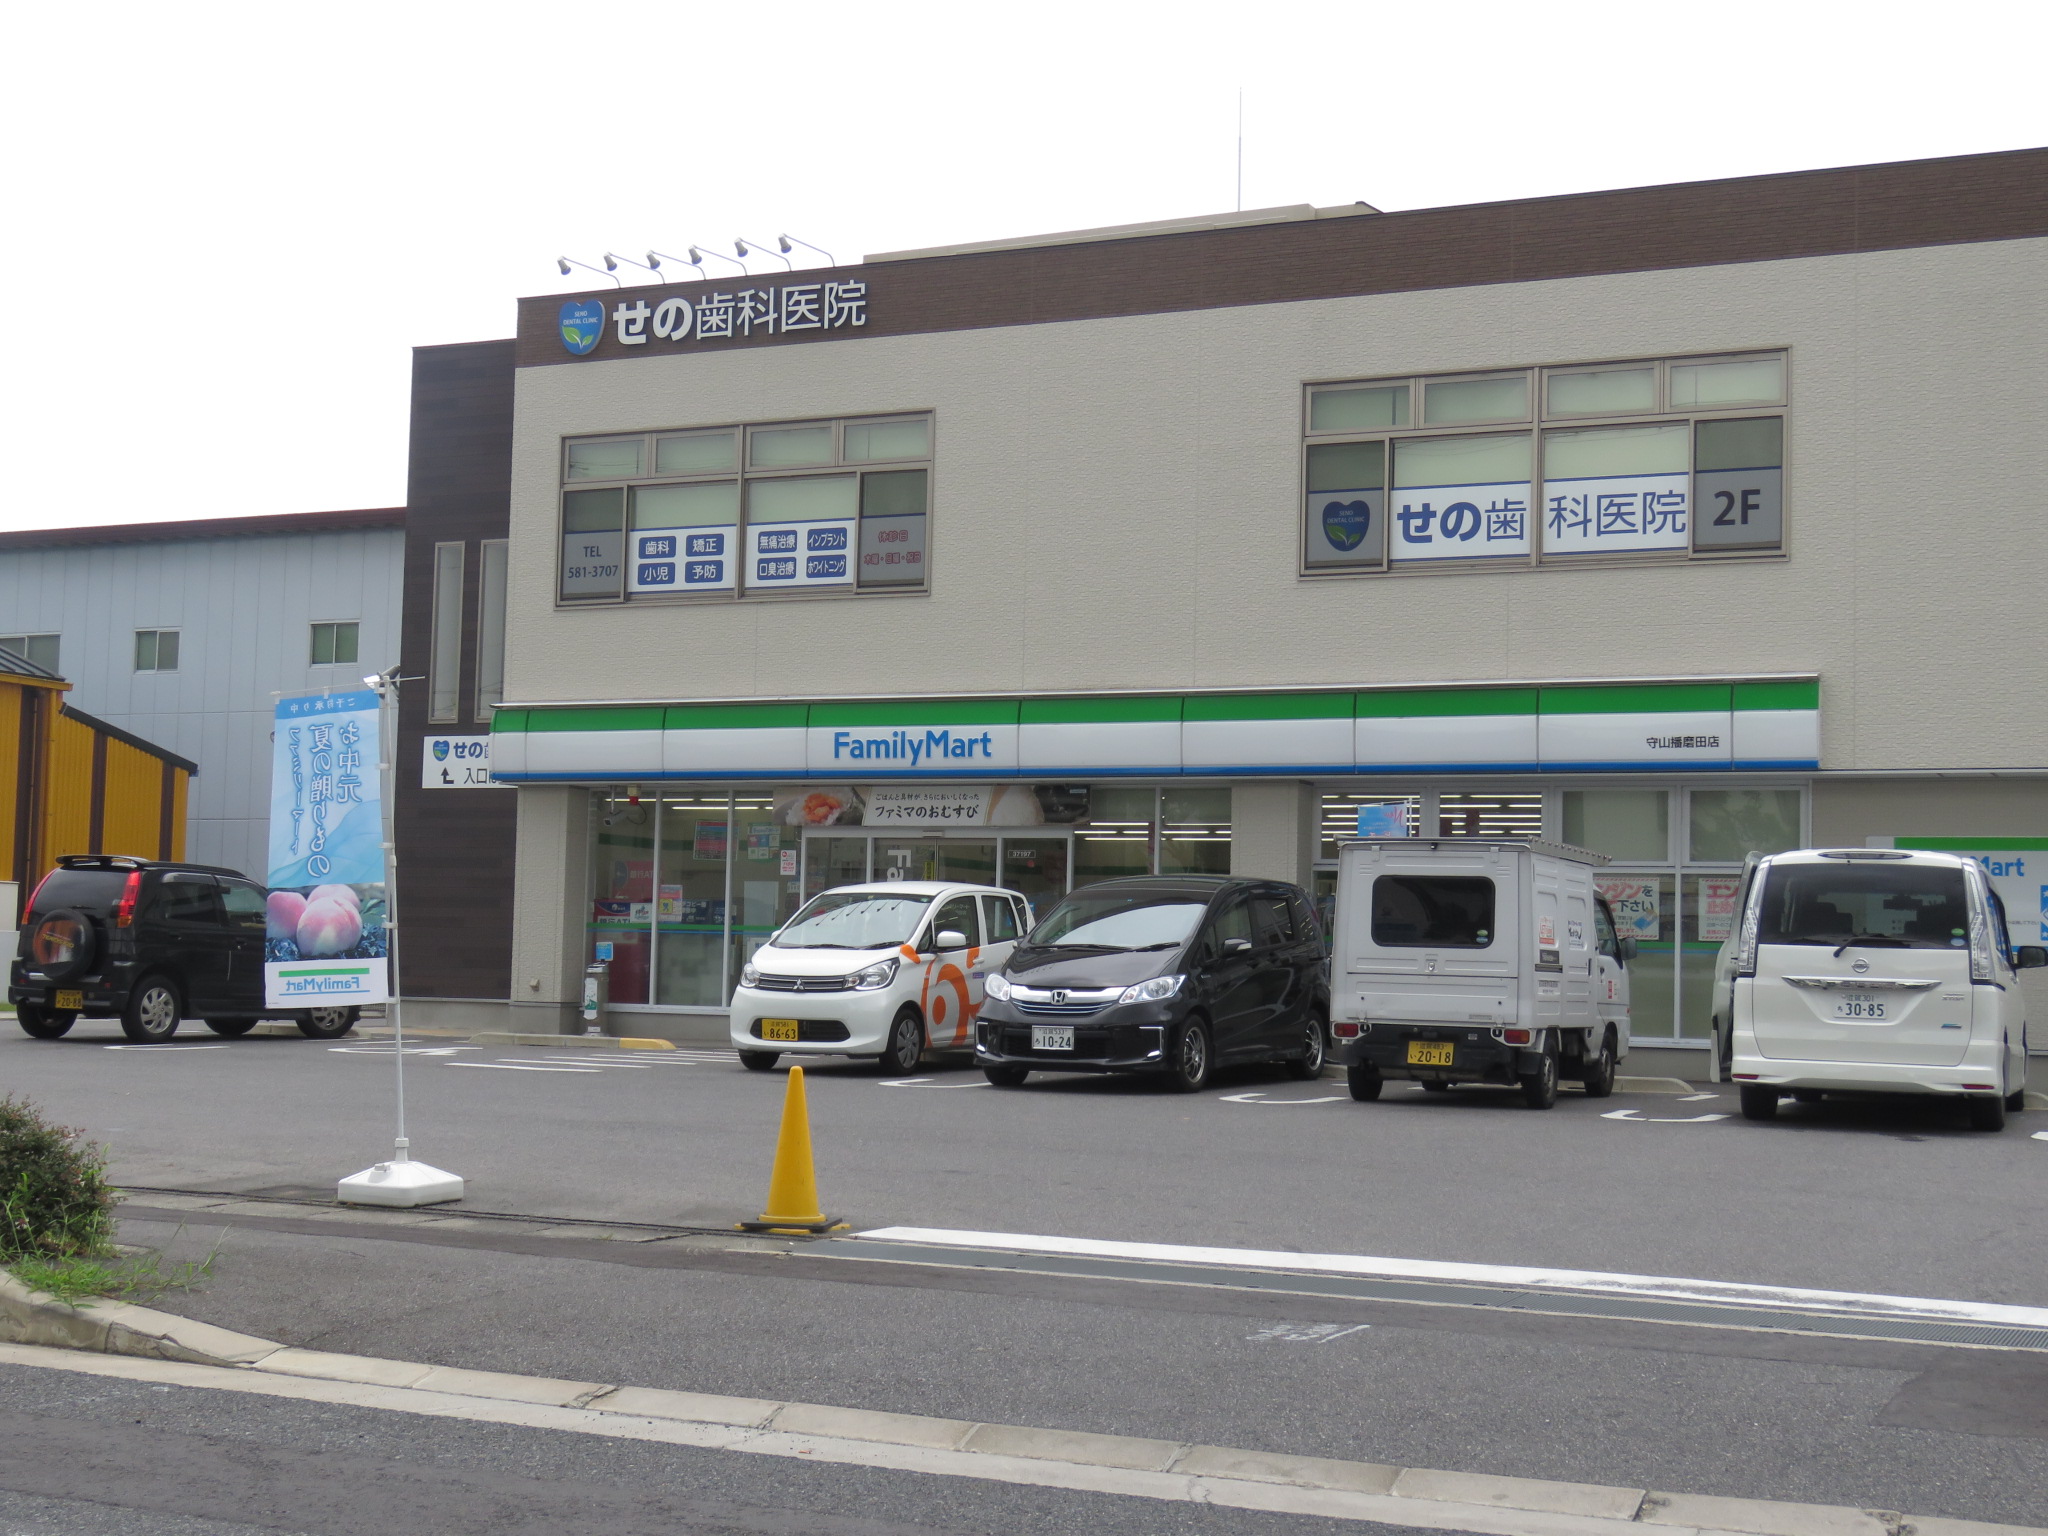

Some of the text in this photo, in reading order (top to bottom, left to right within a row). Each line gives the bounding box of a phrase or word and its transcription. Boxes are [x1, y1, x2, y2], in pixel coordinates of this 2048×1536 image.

[574, 310, 588, 318] SENO
[612, 279, 867, 345] せの歯科医院
[582, 316, 599, 325] CLINIC
[1713, 489, 1761, 526] 2F
[1348, 515, 1365, 523] CLINIC
[759, 534, 796, 550] 無痛治療
[808, 533, 846, 548] インプラント
[878, 530, 909, 543] 休診日
[583, 545, 602, 558] TEL
[645, 540, 670, 556] 歯科
[692, 538, 717, 553] 矯正
[568, 565, 619, 579] 581-3707
[692, 564, 717, 580] 予防
[759, 562, 795, 577] 口臭治療
[807, 559, 846, 573] ホワイトニング
[644, 566, 669, 581] 小児
[834, 730, 992, 766] FamilyMart
[1646, 735, 1720, 749] 守山播磨田店
[874, 804, 980, 819] ファミマのおむすび
[1845, 1003, 1885, 1017] 30-85
[769, 1028, 796, 1039] 86-63
[1042, 1036, 1071, 1048] 10-24
[1417, 1051, 1452, 1064] 20-18
